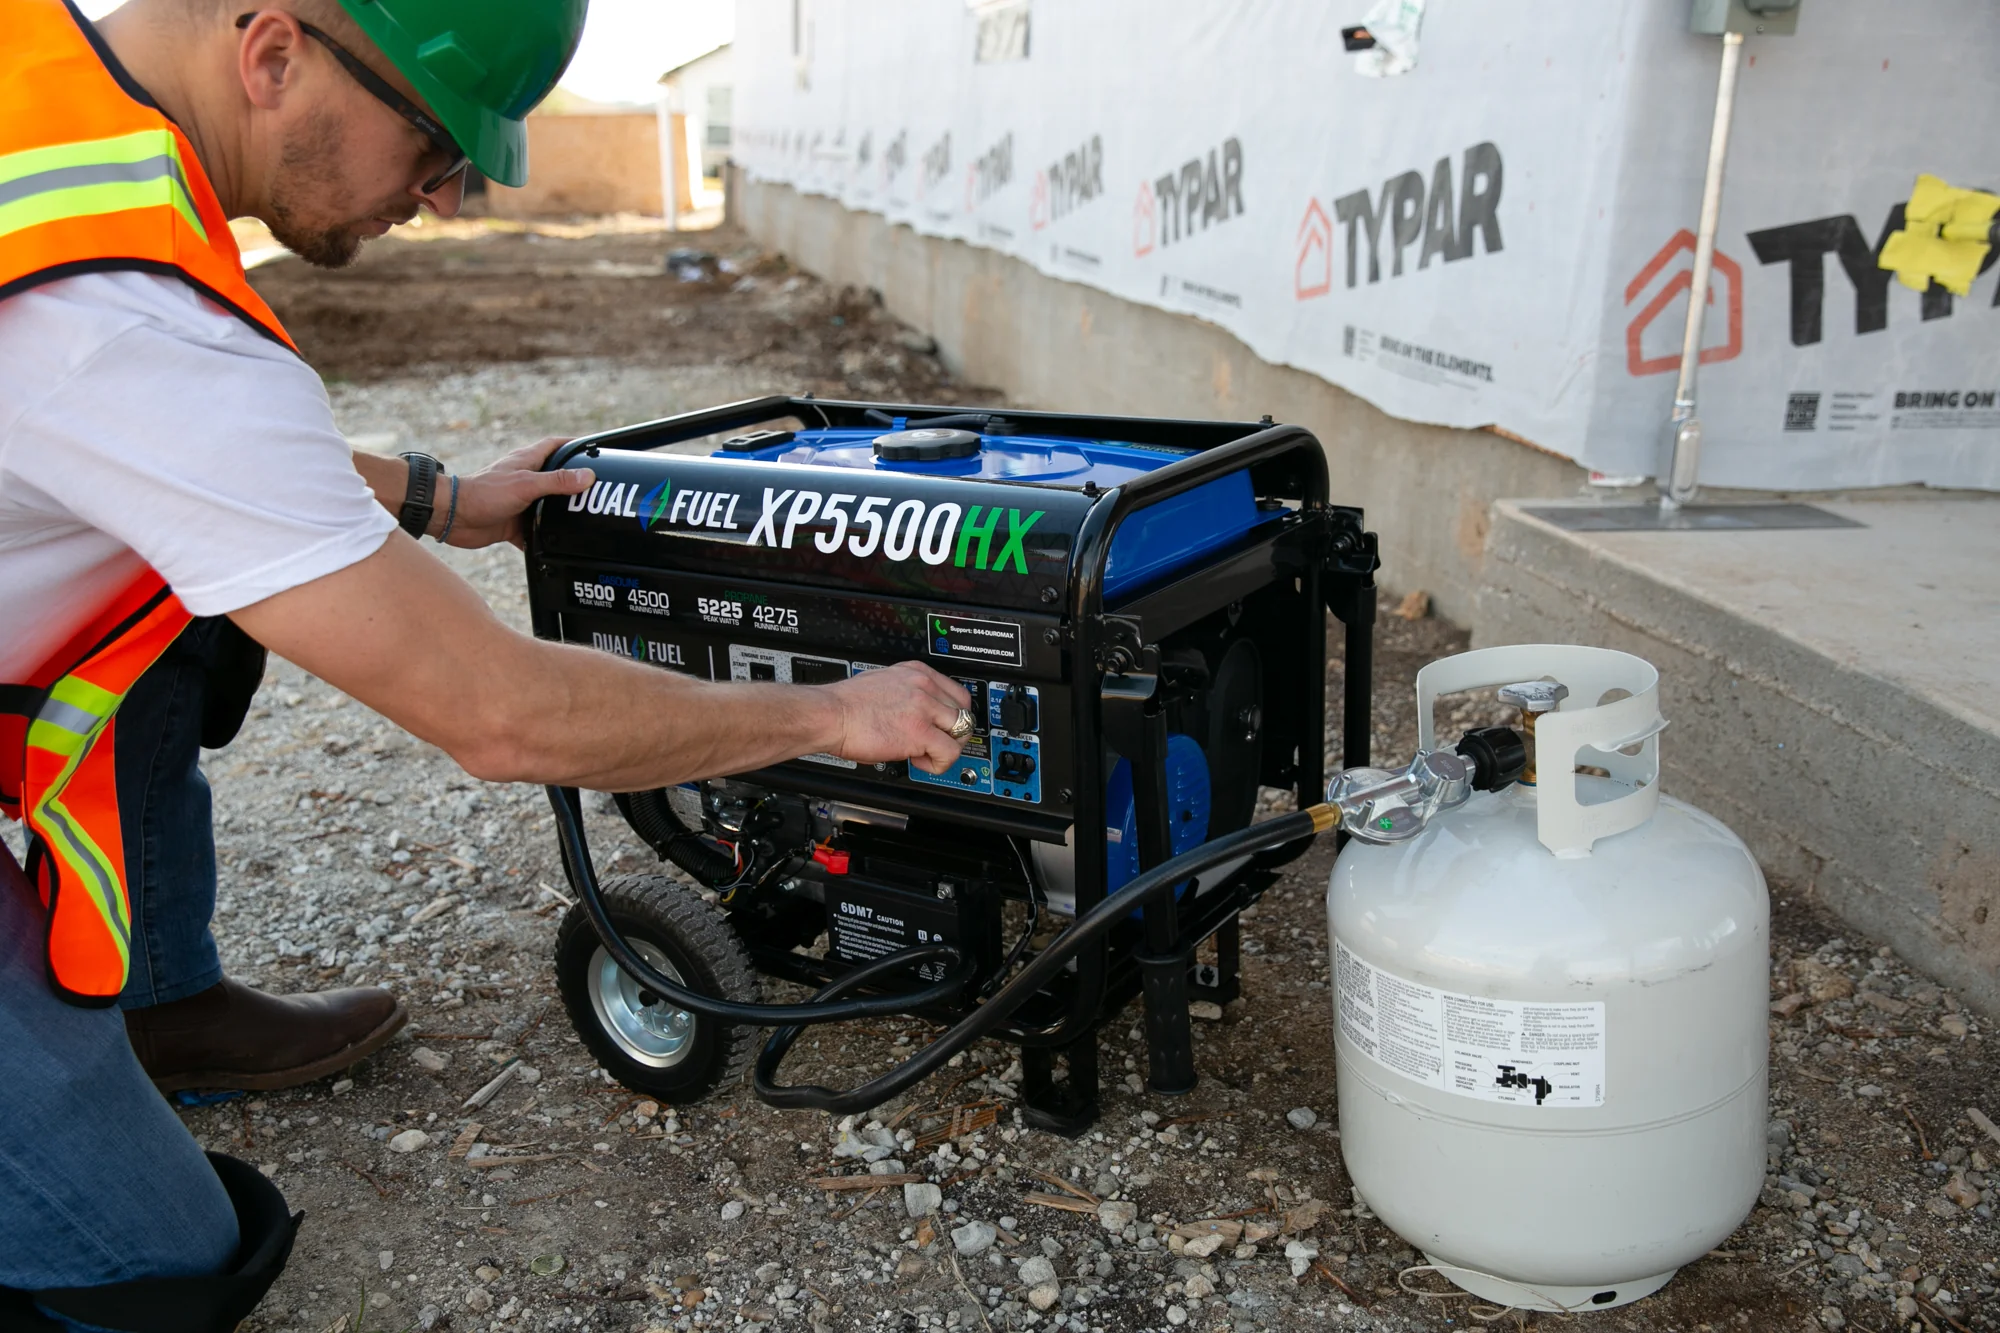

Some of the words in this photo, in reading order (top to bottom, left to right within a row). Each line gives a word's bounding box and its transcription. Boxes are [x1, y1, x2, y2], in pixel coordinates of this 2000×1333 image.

[1156, 137, 1244, 247] TYPAR
[1334, 141, 1505, 289] TYPAR
[1895, 391, 1961, 409] BRING
[1964, 391, 1996, 408] ON
[568, 481, 639, 518] DUAL
[669, 489, 740, 529] FUEL
[747, 487, 1046, 574] XP5500HX
[598, 574, 641, 588] GASOLINE
[574, 581, 615, 602] 5500
[628, 589, 669, 609] 4500
[724, 590, 768, 605] PROPANE
[579, 598, 593, 606] PEAK
[594, 600, 612, 608] WATTS
[629, 604, 652, 614] RUNNING
[653, 608, 670, 616] WATTS
[698, 597, 743, 619] 5225
[752, 605, 798, 627] 4275
[703, 614, 718, 623] PEAK
[719, 617, 739, 626] WATTS
[754, 621, 779, 631] RUNNING
[780, 626, 799, 634] WATTS
[950, 625, 973, 634] Support:
[592, 632, 632, 656] DUAL
[648, 641, 685, 665] FUEL
[741, 651, 759, 659] ENGINE
[952, 644, 1014, 657] DUROMAXPOWER.COM
[732, 660, 747, 668] START
[841, 902, 873, 919] 6DM7
[876, 914, 904, 927] CAUTION
